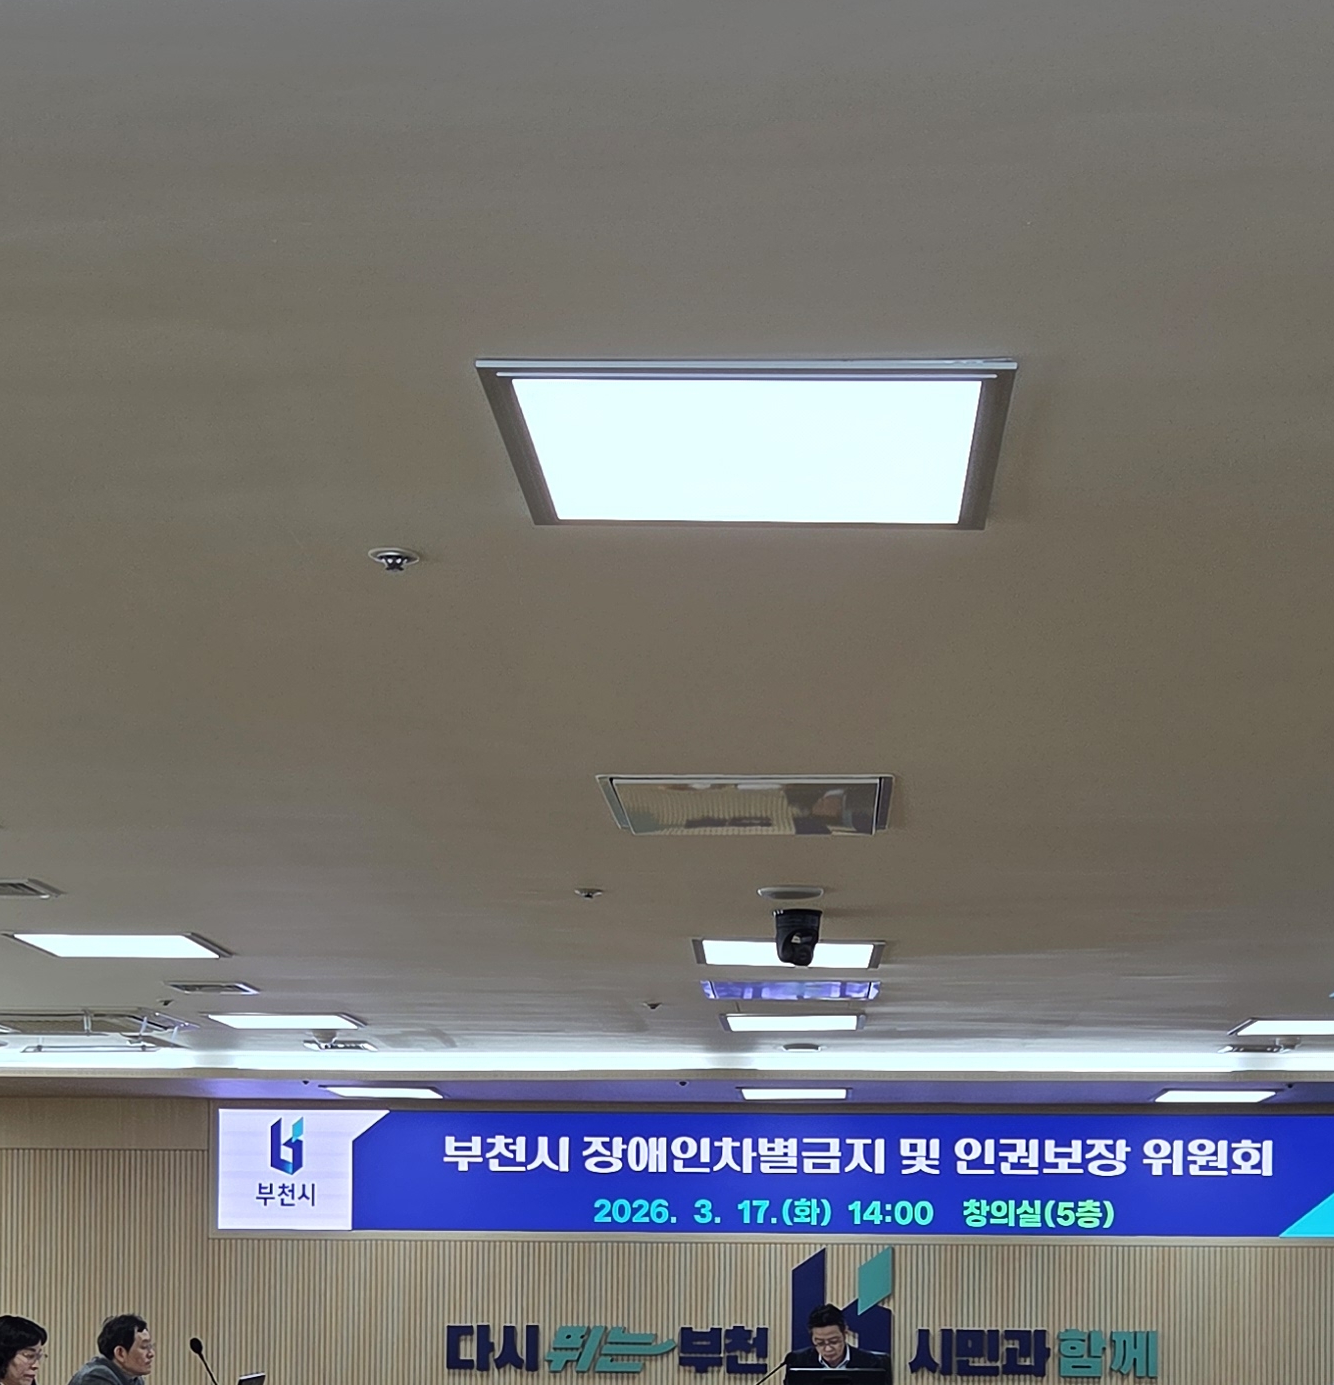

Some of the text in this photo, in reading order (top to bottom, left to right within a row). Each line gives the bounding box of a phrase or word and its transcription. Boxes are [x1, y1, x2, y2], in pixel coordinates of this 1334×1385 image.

[443, 1135, 1274, 1177] 부천시 장애인차별금지 및 인권보장 위원회
[255, 1183, 316, 1207] 부천시
[593, 1198, 1114, 1228] 2026. 3. 17.(화) 14:00 창의실(5층)
[446, 1324, 1158, 1378] 다시 뛰는 부천 시민과 함께
